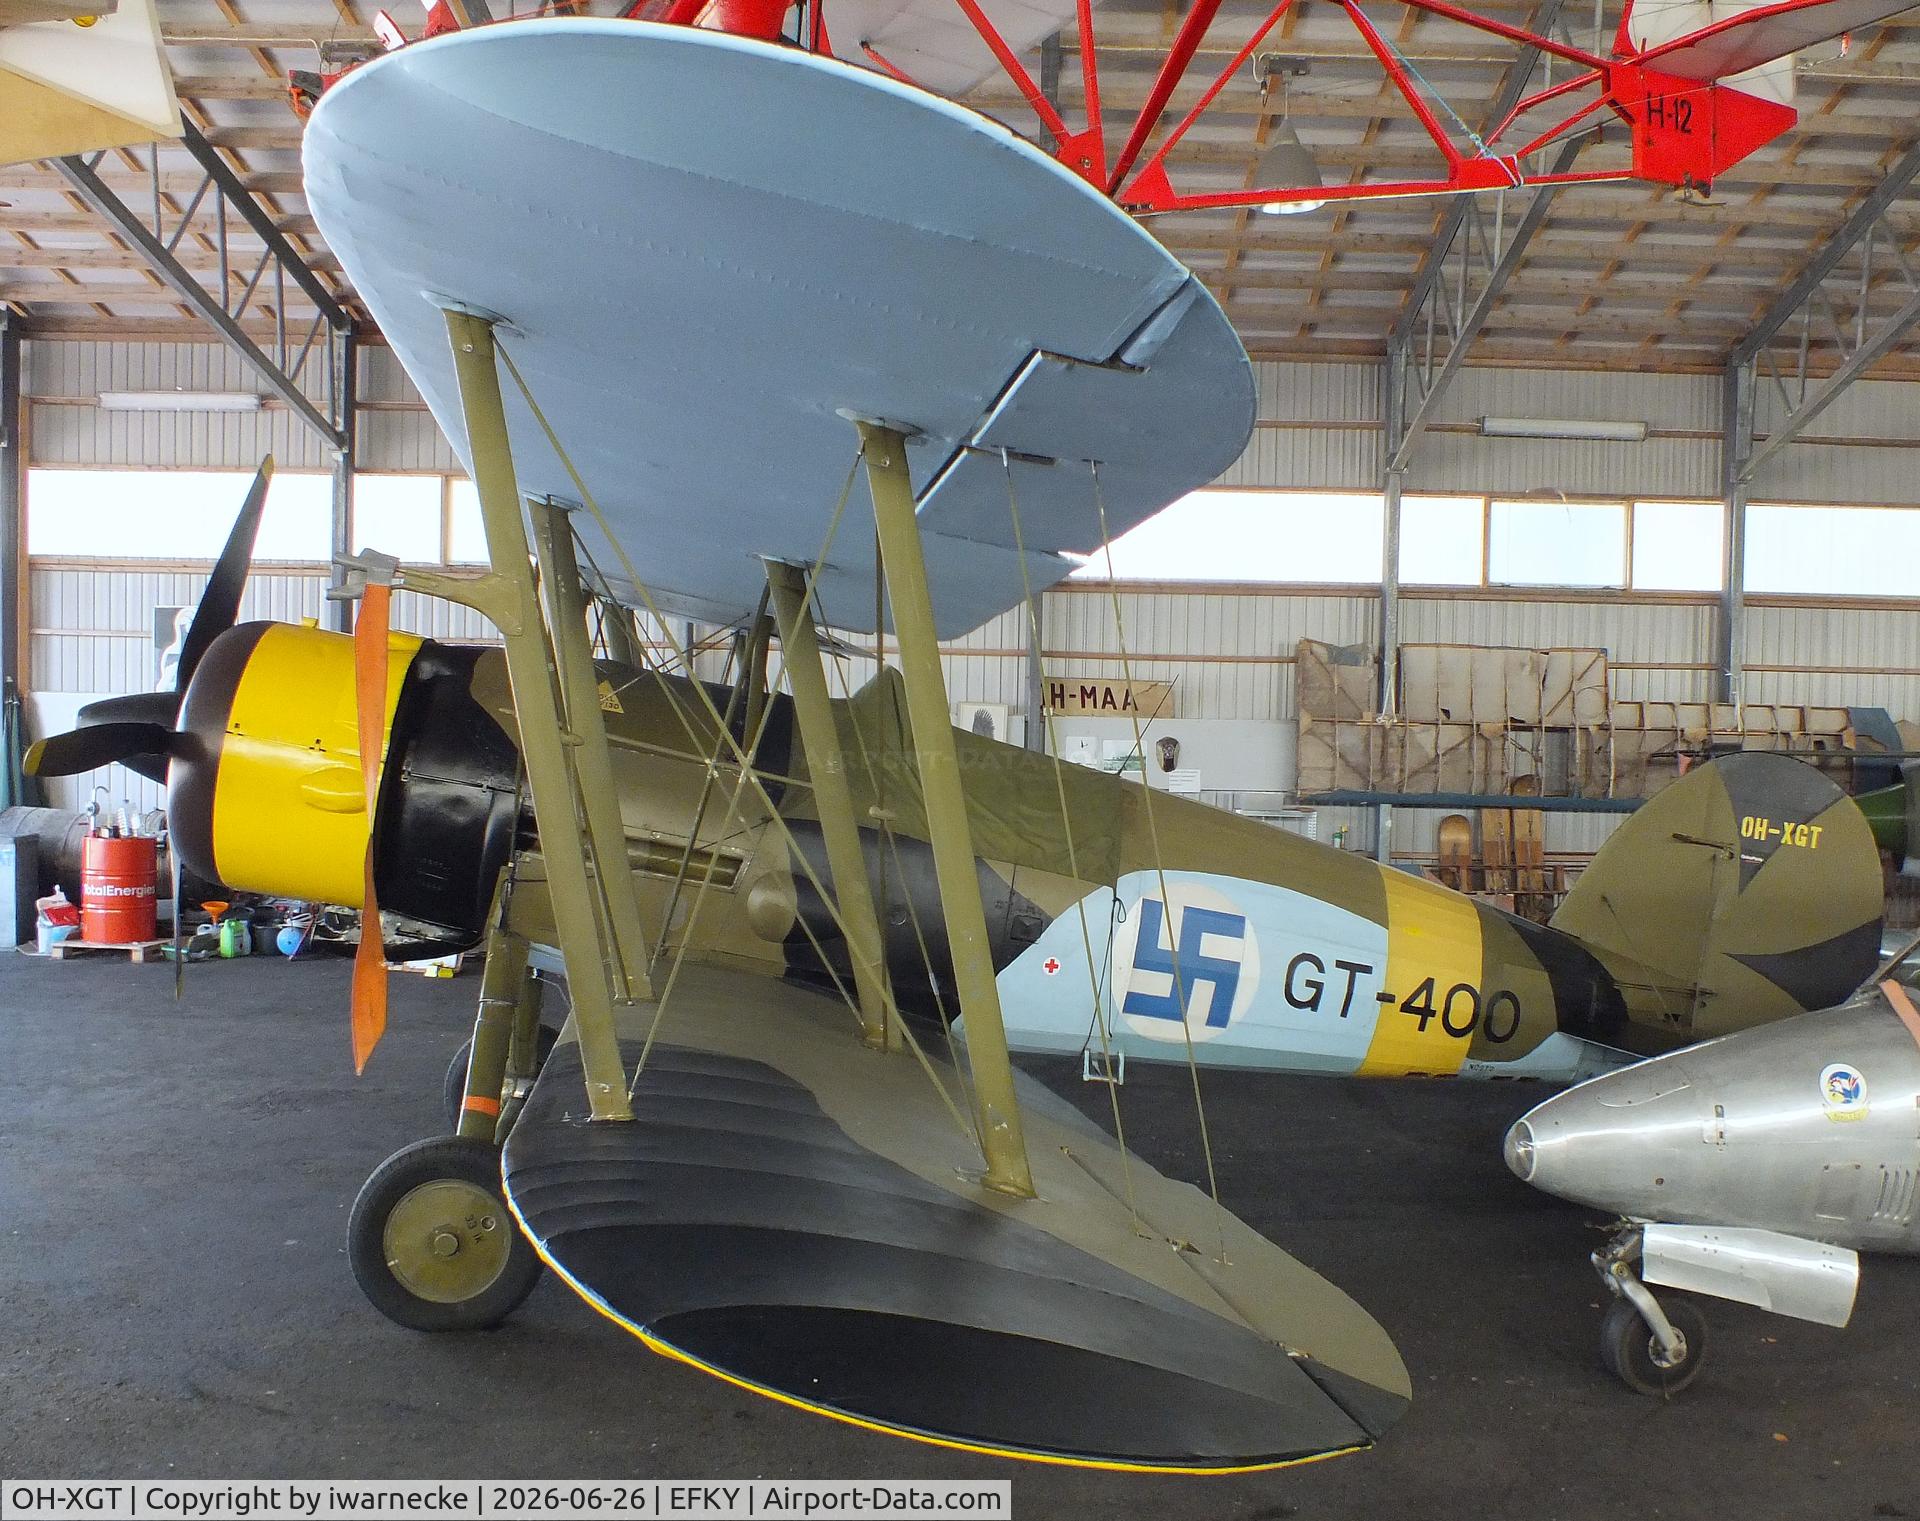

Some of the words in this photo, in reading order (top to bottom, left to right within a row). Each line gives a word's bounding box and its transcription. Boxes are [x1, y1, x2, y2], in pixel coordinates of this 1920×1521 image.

[1647, 92, 1692, 134] H-12
[1041, 682, 1139, 711] H-MAA
[1741, 816, 1823, 849] OH-XGT
[1284, 952, 1521, 1044] GT-400
